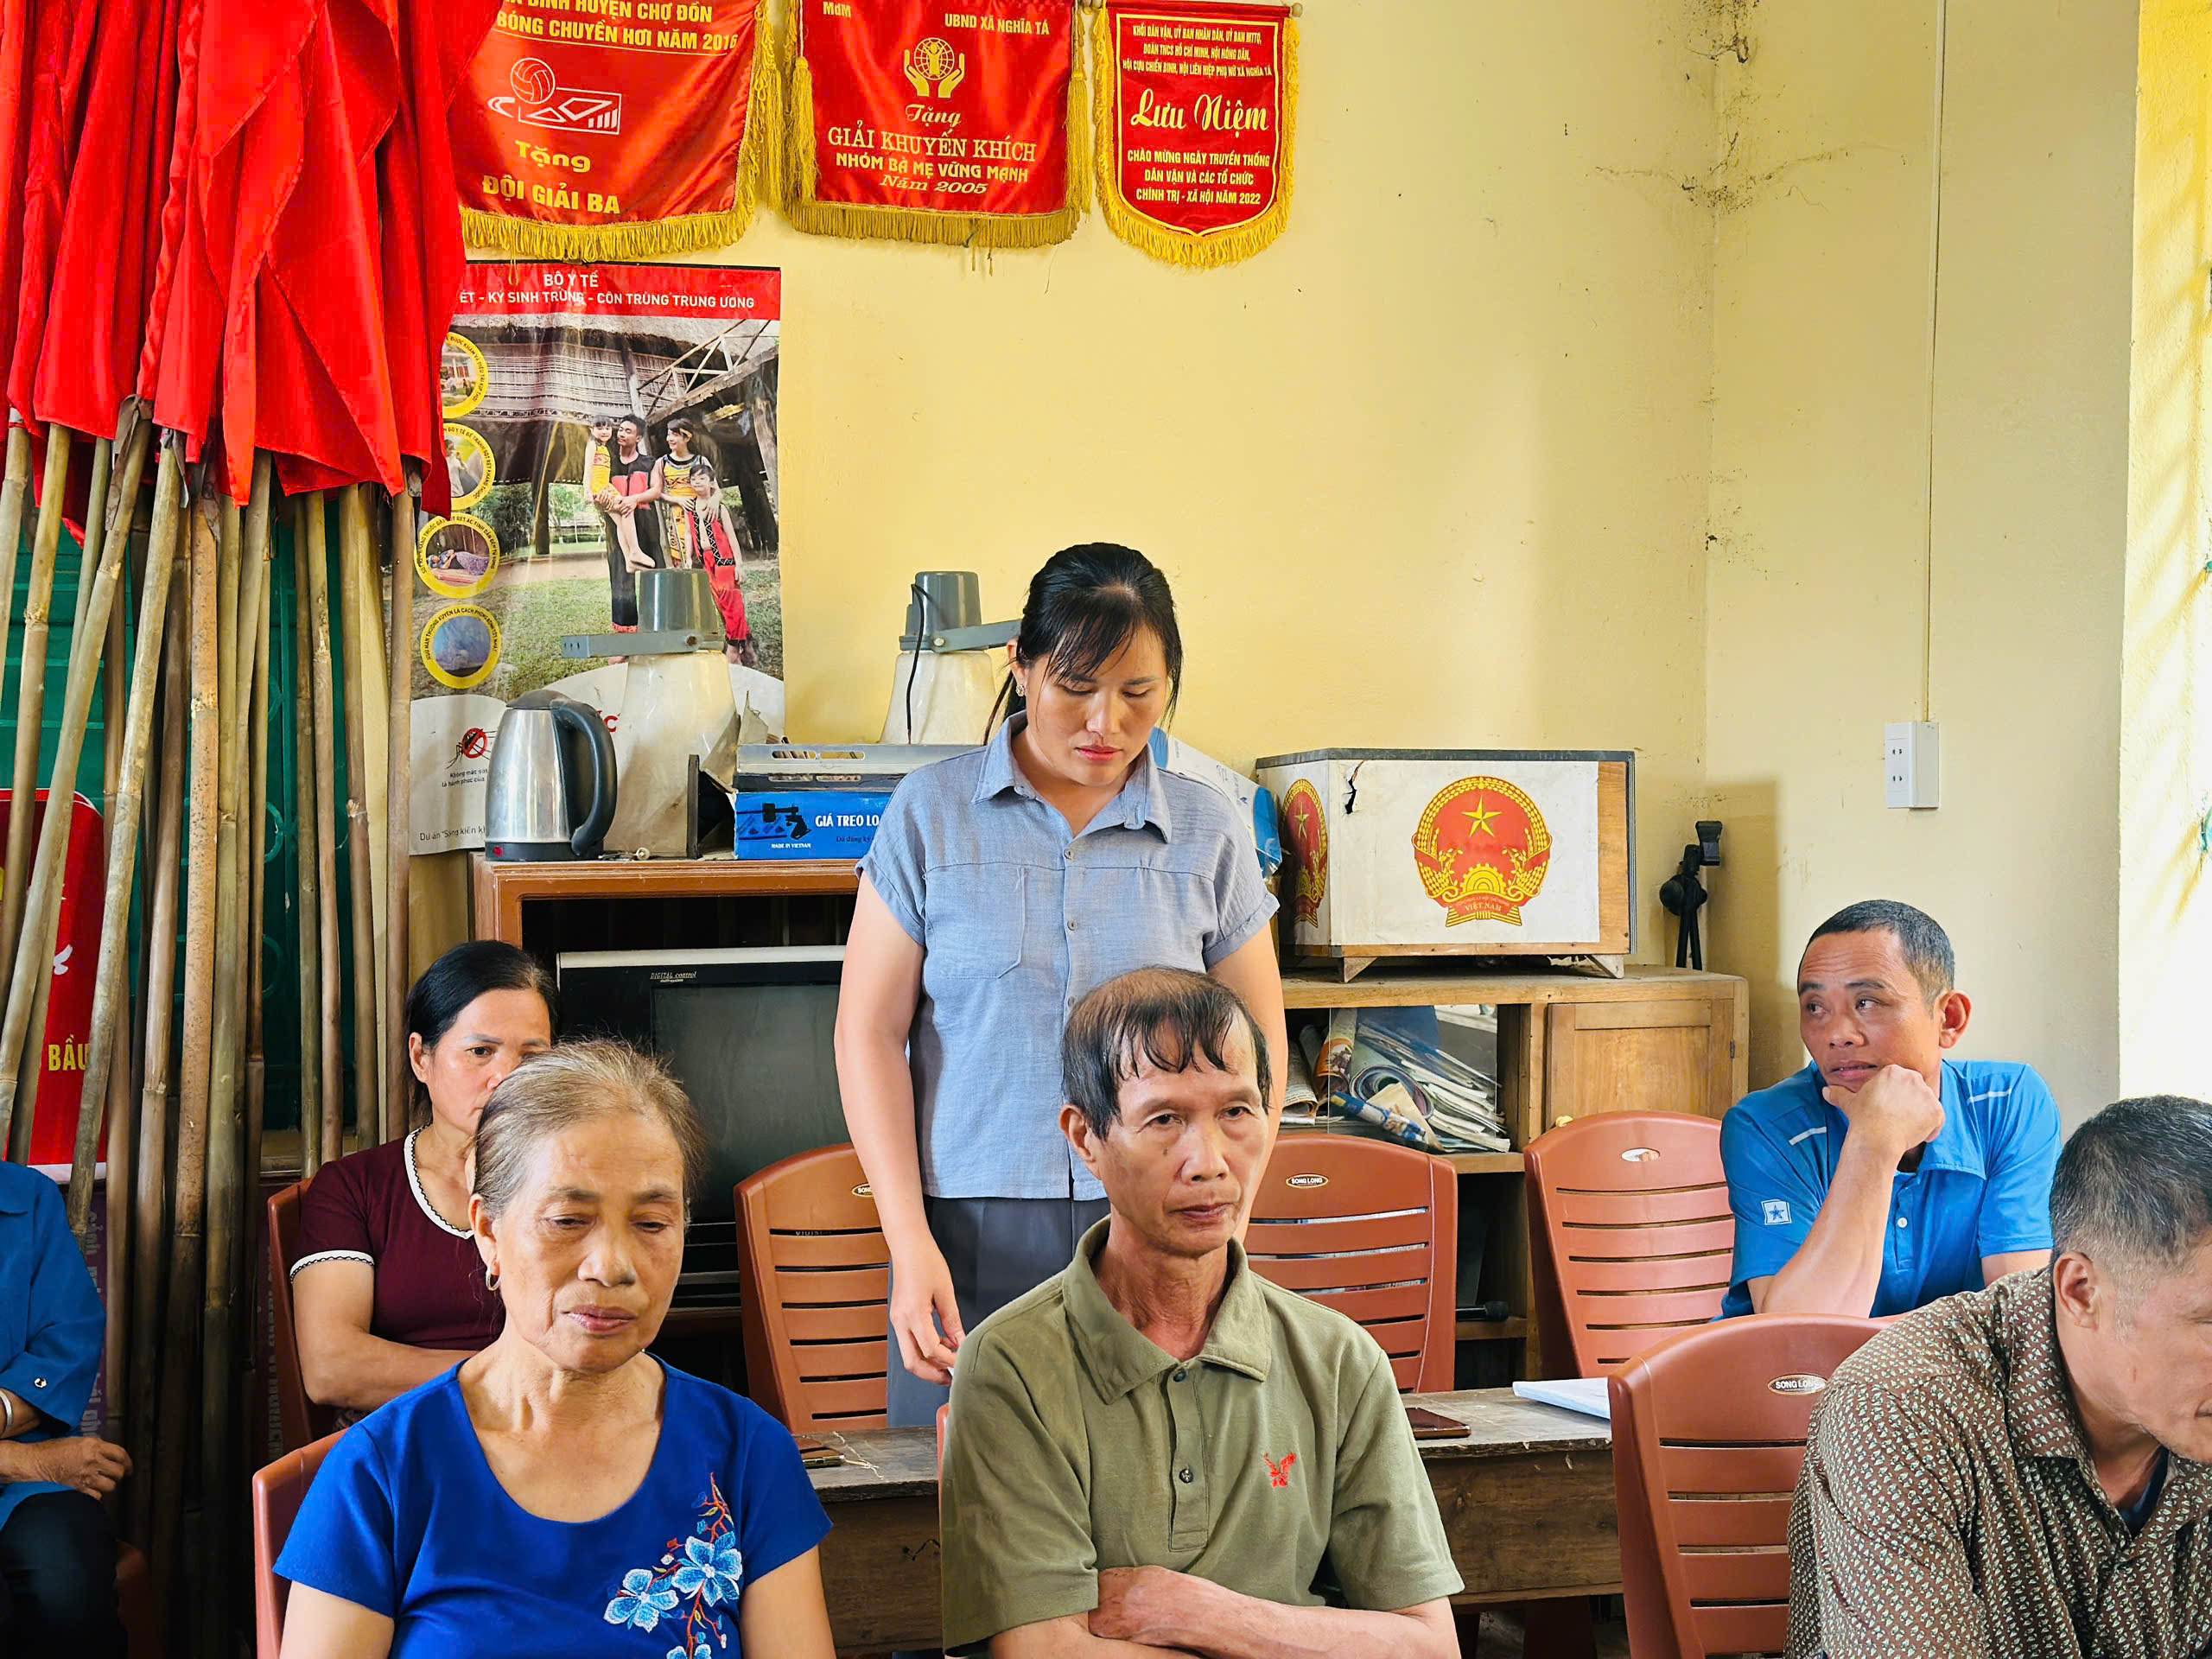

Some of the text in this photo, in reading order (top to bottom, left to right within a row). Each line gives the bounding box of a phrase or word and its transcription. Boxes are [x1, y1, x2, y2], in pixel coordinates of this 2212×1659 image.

[575, 0, 712, 24] HUYỆN CHỢ ĐỒN
[497, 10, 543, 35] BÓNG
[549, 18, 618, 43] CHUYỀN
[623, 27, 652, 47] HƠI
[658, 29, 697, 49] NĂM
[944, 14, 1050, 35] UBND XÃ NGHĨA TÁ
[906, 103, 962, 128] Tặng
[1130, 88, 1269, 138] Lưu Niệm
[828, 120, 1037, 162] GIẢI KHUYẾN KHÍCH
[515, 140, 591, 173] Tặng
[1128, 148, 1152, 162] CHÀO
[1184, 150, 1207, 165] NGÀY
[836, 152, 884, 170] NHÓM
[913, 161, 934, 177] MẸ
[938, 161, 982, 179] VỮNG
[987, 165, 1028, 183] MẠNH
[1145, 167, 1164, 181] DÂN
[1166, 168, 1184, 185] VẬN
[1199, 169, 1215, 184] CÁC
[1230, 171, 1255, 186] CHỨC
[482, 174, 620, 214] ĐỘI GIẢI BA
[879, 175, 989, 194] Năm 2005
[1166, 189, 1180, 205] TRỊ
[1186, 189, 1198, 203] XÃ
[1199, 189, 1214, 206] HỘI
[1216, 189, 1237, 204] NĂM
[1239, 193, 1262, 205] 2022
[567, 274, 576, 287] Y
[580, 270, 599, 288] TẾ
[460, 289, 475, 303] ÉT
[488, 289, 505, 303] KÝ
[507, 291, 539, 303] SINH
[542, 286, 584, 303] TRÙNG
[597, 291, 622, 305] CÔN
[626, 290, 670, 306] TRÙNG
[672, 295, 716, 308] TRUNG
[815, 812, 834, 827] GIÁ
[836, 815, 865, 827] TREO
[675, 970, 696, 979] control
[1775, 1380, 1797, 1389] SONG
